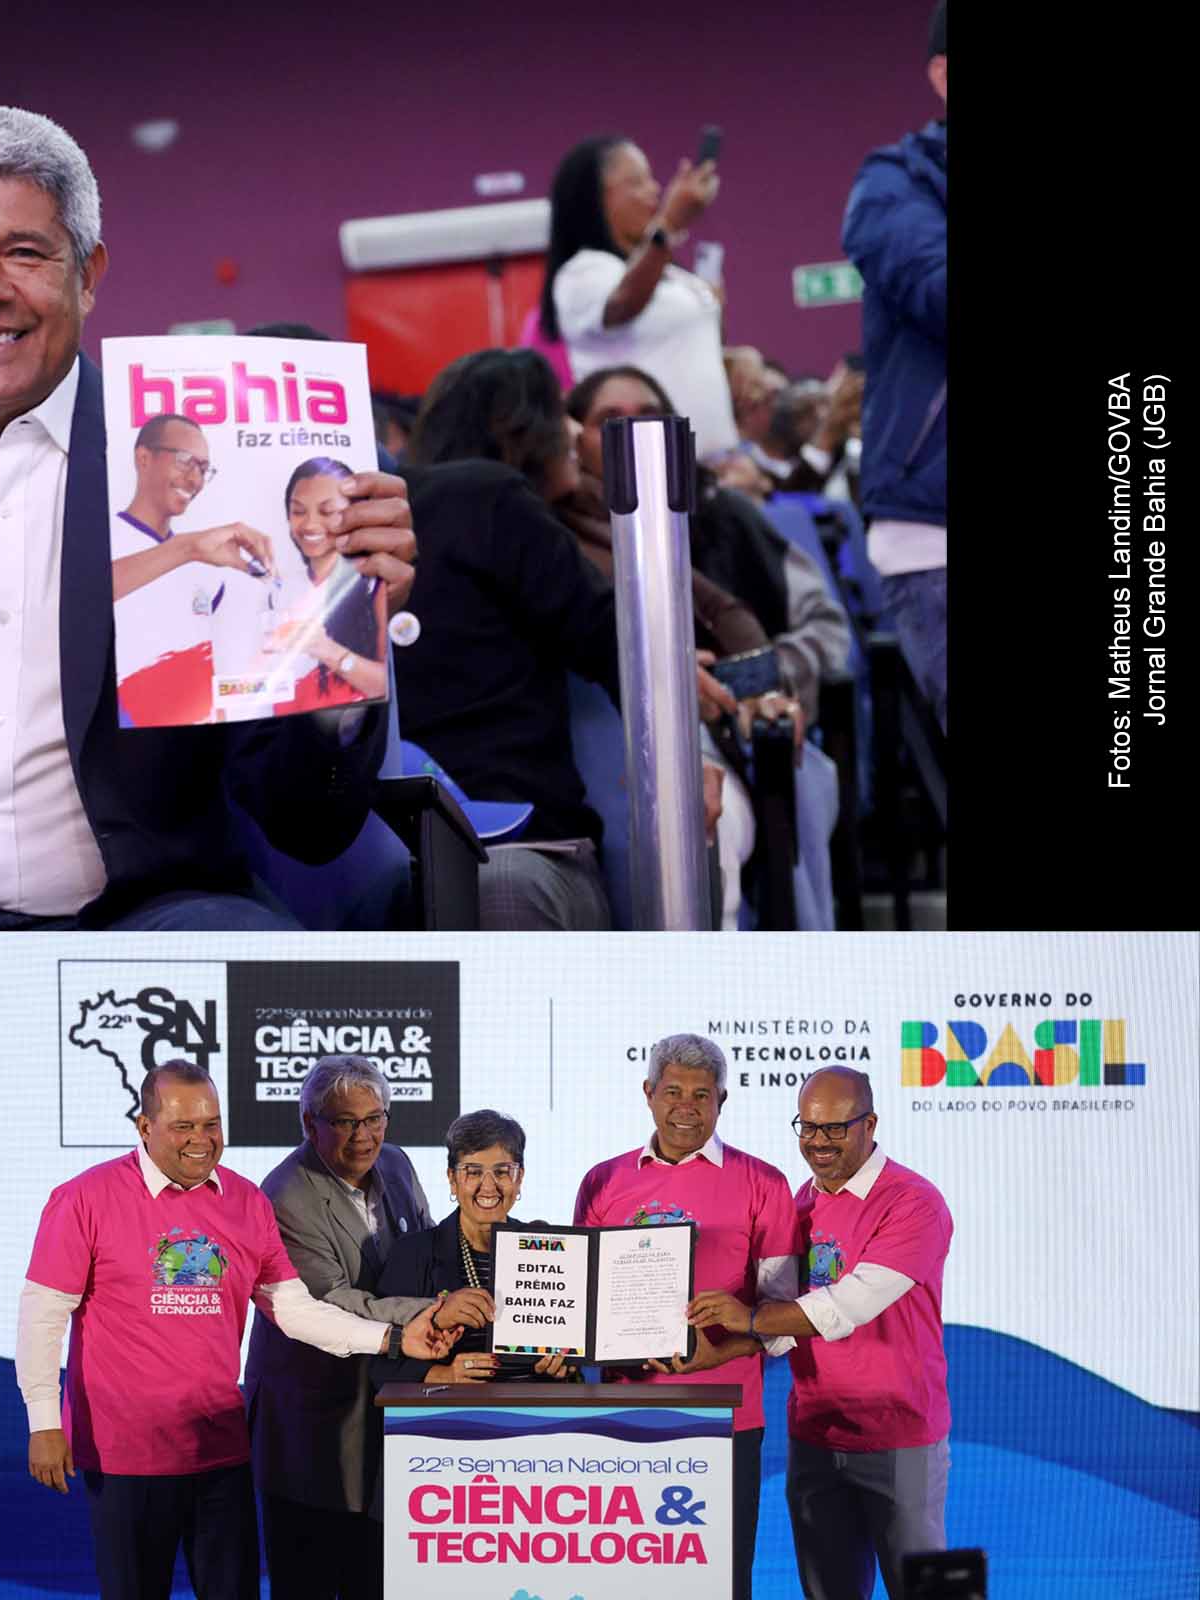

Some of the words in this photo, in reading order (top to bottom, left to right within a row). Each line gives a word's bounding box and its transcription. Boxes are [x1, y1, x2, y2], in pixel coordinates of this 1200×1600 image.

[128, 361, 349, 428] bahia
[237, 430, 272, 448] faz
[279, 427, 351, 448] ciência
[954, 993, 1052, 1008] GOVERNO
[1065, 992, 1094, 1007] DO
[284, 1007, 347, 1019] Semana
[349, 1007, 411, 1019] Nacional
[708, 1017, 834, 1035] MINISTÉRIO
[844, 1019, 871, 1035] DA
[255, 1018, 395, 1053] CIÊNCIA
[400, 1025, 432, 1053] &
[731, 1046, 871, 1061] TECNOLOGIA
[900, 1018, 1146, 1087] BRASIL
[255, 1056, 432, 1079] TECOGIA
[740, 1072, 750, 1087] E
[266, 1087, 281, 1096] 20
[392, 1087, 423, 1096] 2025
[912, 1100, 933, 1112] DO
[938, 1100, 977, 1112] LADO
[982, 1100, 1002, 1112] DO
[1007, 1100, 1048, 1112] POVO
[1053, 1099, 1135, 1111] BRASILEIRO
[519, 1239, 565, 1251] BAHIA
[518, 1263, 564, 1274] EDITAL
[515, 1279, 566, 1291] PRÊMIO
[150, 1305, 222, 1315] TECNOLOGIA
[505, 1297, 546, 1307] BAHIA
[550, 1299, 575, 1308] FAZ
[512, 1313, 567, 1325] CIÊNCIA
[408, 1456, 454, 1473] 22ª
[458, 1456, 563, 1474] Semana
[568, 1456, 671, 1474] Nacional
[675, 1457, 708, 1474] de
[408, 1474, 645, 1525] CIÊNCIA
[655, 1485, 707, 1526] &
[408, 1531, 708, 1565] TECNOLOGIA
